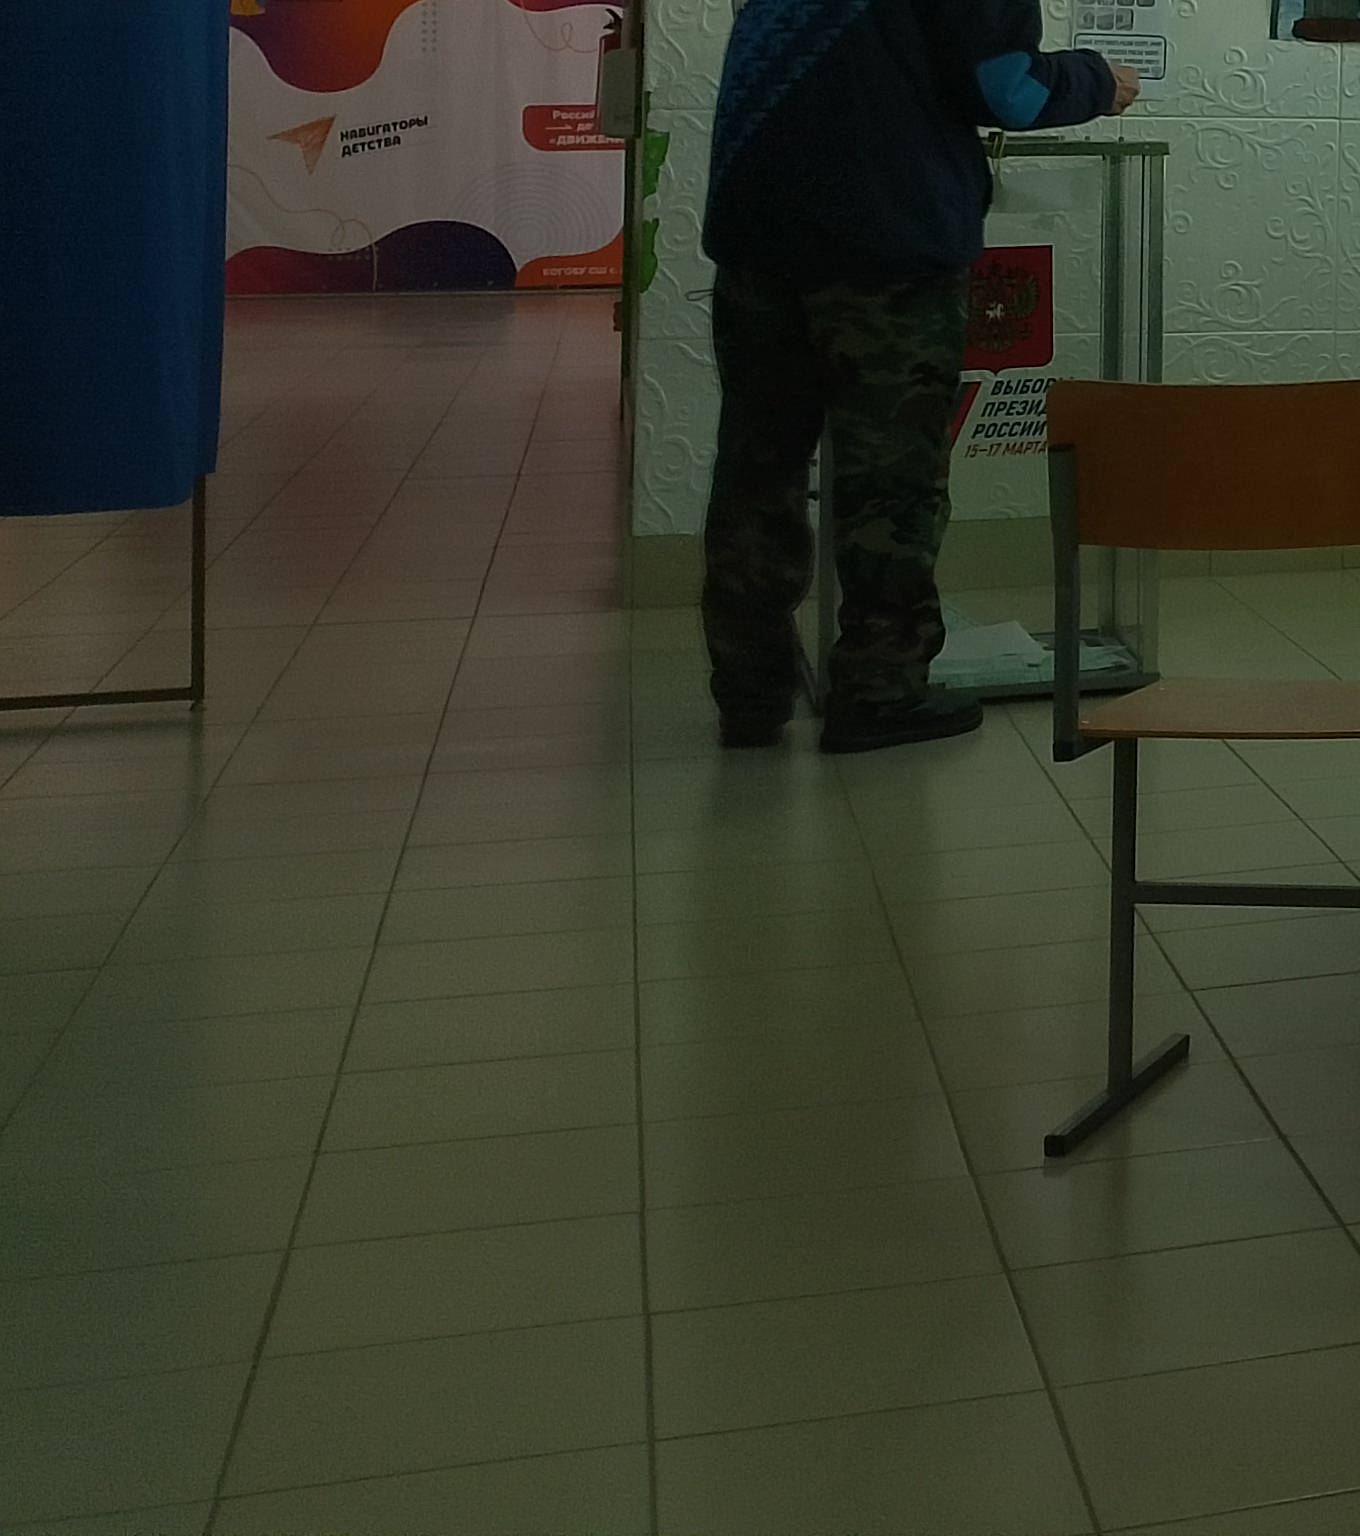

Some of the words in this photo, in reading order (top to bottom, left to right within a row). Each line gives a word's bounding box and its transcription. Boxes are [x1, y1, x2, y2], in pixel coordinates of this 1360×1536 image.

[340, 115, 429, 143] НАВИГАТОРЫ
[341, 135, 402, 158] ДЕТСТВА
[990, 377, 1057, 395] ВЫБОР
[971, 420, 1048, 439] РОССИИ
[1002, 440, 1048, 456] МАРТА
